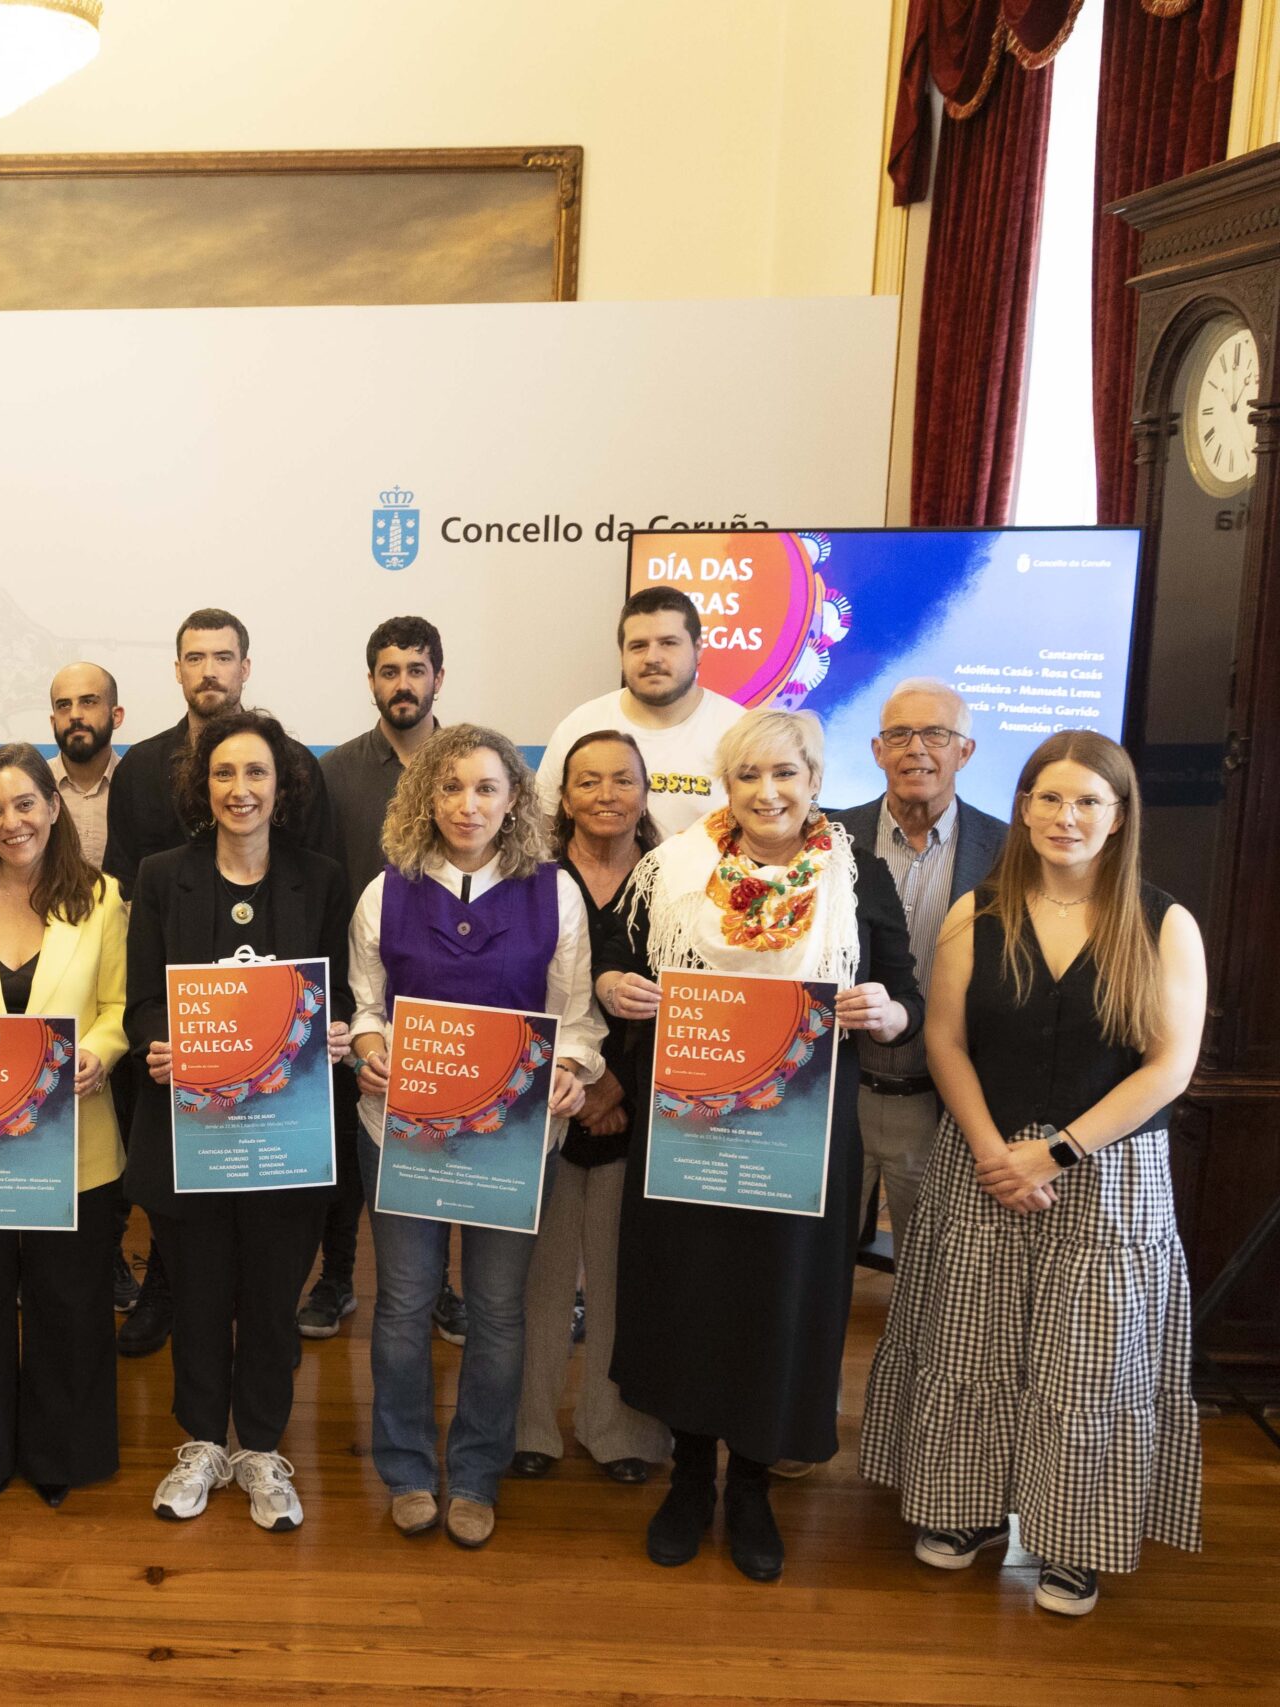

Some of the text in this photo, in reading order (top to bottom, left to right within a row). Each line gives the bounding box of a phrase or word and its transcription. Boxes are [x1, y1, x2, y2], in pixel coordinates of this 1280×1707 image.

[441, 514, 583, 543] Concello
[594, 514, 634, 542] da
[648, 553, 753, 581] DÍA DAS
[683, 592, 740, 616] RAS
[700, 626, 763, 651] EGAS
[1039, 649, 1105, 661] Cantareiras
[954, 664, 1000, 676] Adolfina
[1041, 667, 1068, 678] Rosa
[1070, 669, 1103, 680] Casás
[1019, 686, 1068, 697] Manuela
[1070, 688, 1102, 699] Lema
[968, 701, 1100, 717] rcía Prudencia Garrido
[649, 772, 712, 796] ESTE
[177, 980, 248, 997] FOLIADA
[669, 985, 746, 1004] FOLIADA
[178, 1001, 210, 1015] DAS
[668, 1005, 703, 1020] DAS
[179, 1019, 237, 1035] LETRAS
[405, 1013, 475, 1037] DÍA DAS
[667, 1024, 731, 1042] LETRAS
[179, 1037, 253, 1055] GALEGAS
[403, 1036, 466, 1057] LETRAS
[665, 1043, 746, 1063] GALEGAS
[400, 1056, 480, 1079] GALEGAS
[399, 1078, 437, 1094] 2025
